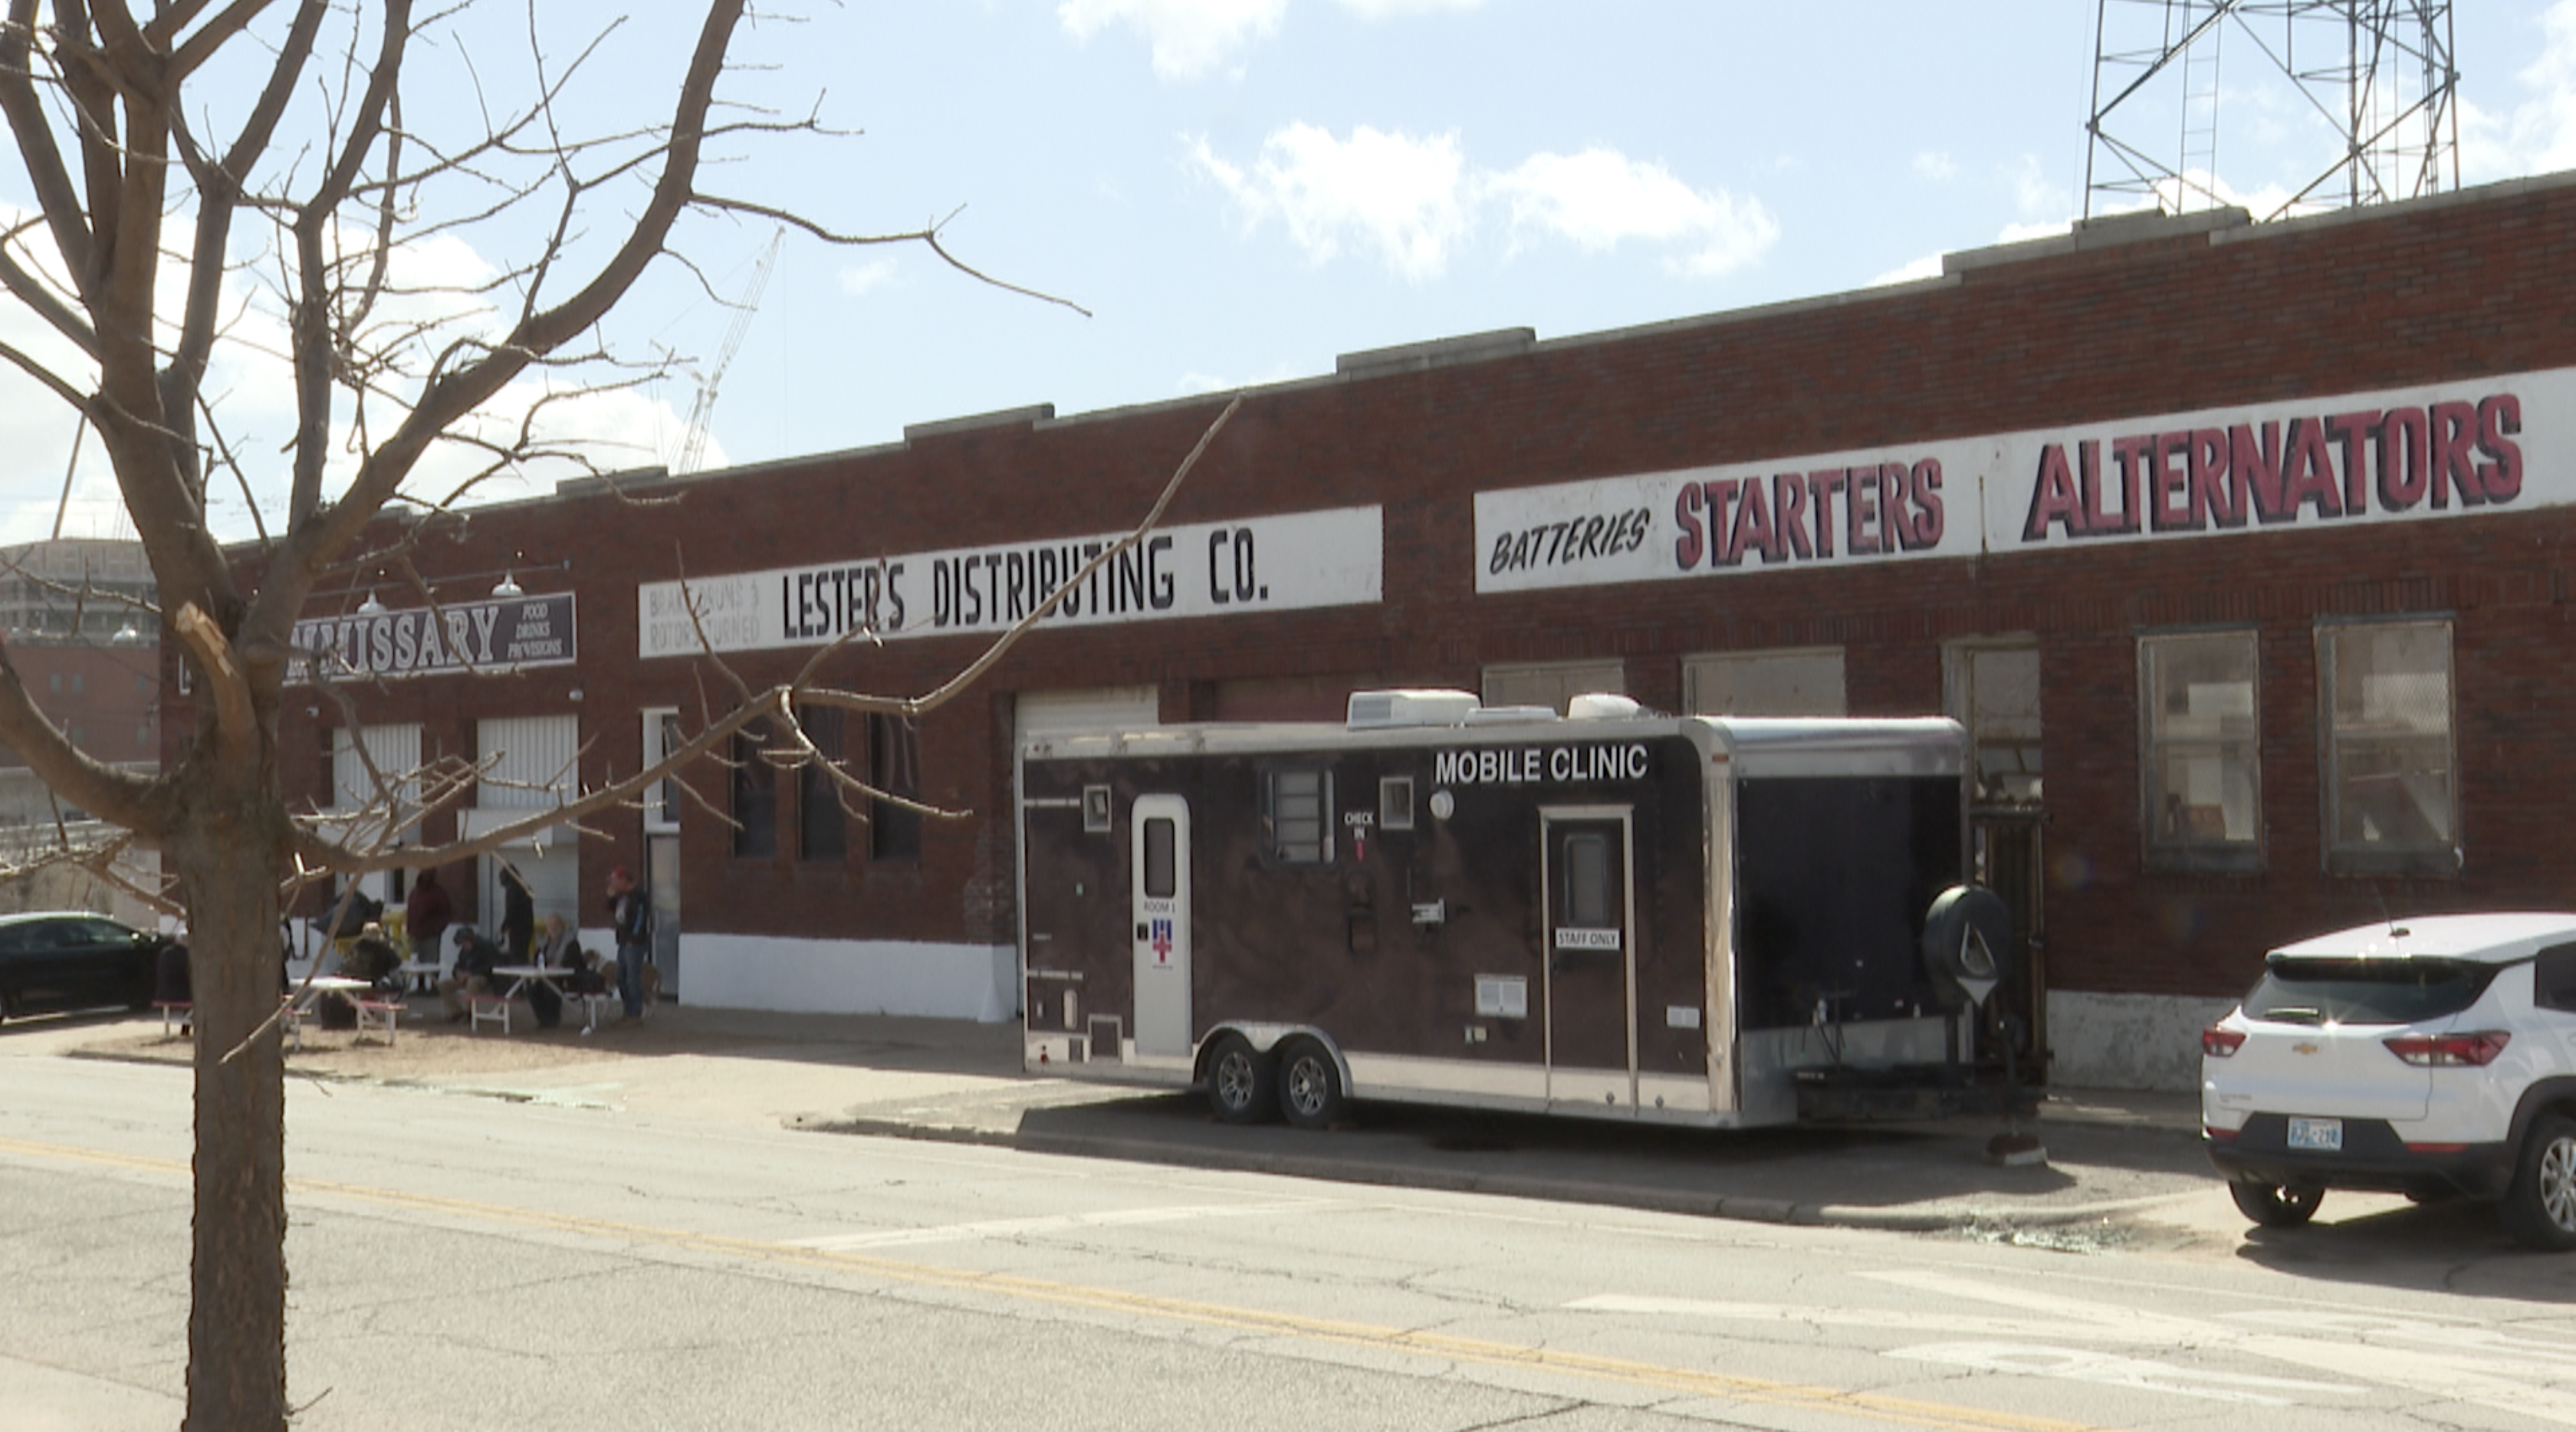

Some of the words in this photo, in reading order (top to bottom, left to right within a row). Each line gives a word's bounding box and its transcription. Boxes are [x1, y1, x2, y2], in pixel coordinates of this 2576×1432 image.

[1490, 507, 1651, 574] BATTERIES
[1674, 458, 1944, 570] STARTERS
[2022, 393, 2524, 541] ALTERNATORS
[783, 562, 905, 639] LESTER'S
[934, 534, 1175, 628] DISTRIBUTING
[1209, 527, 1269, 604] CO.
[522, 603, 548, 620] FOOD
[515, 619, 550, 640] DRINKS
[705, 613, 760, 646] TURNED
[507, 638, 563, 659] PROVISIONS
[1435, 748, 1542, 784] MOBILE
[1550, 743, 1648, 781] CLINIC
[1344, 810, 1374, 826] CHECK
[1353, 826, 1365, 840] IN
[1144, 900, 1170, 913] ROOM
[1558, 931, 1586, 945] STAFF
[1589, 932, 1617, 946] ONLY
